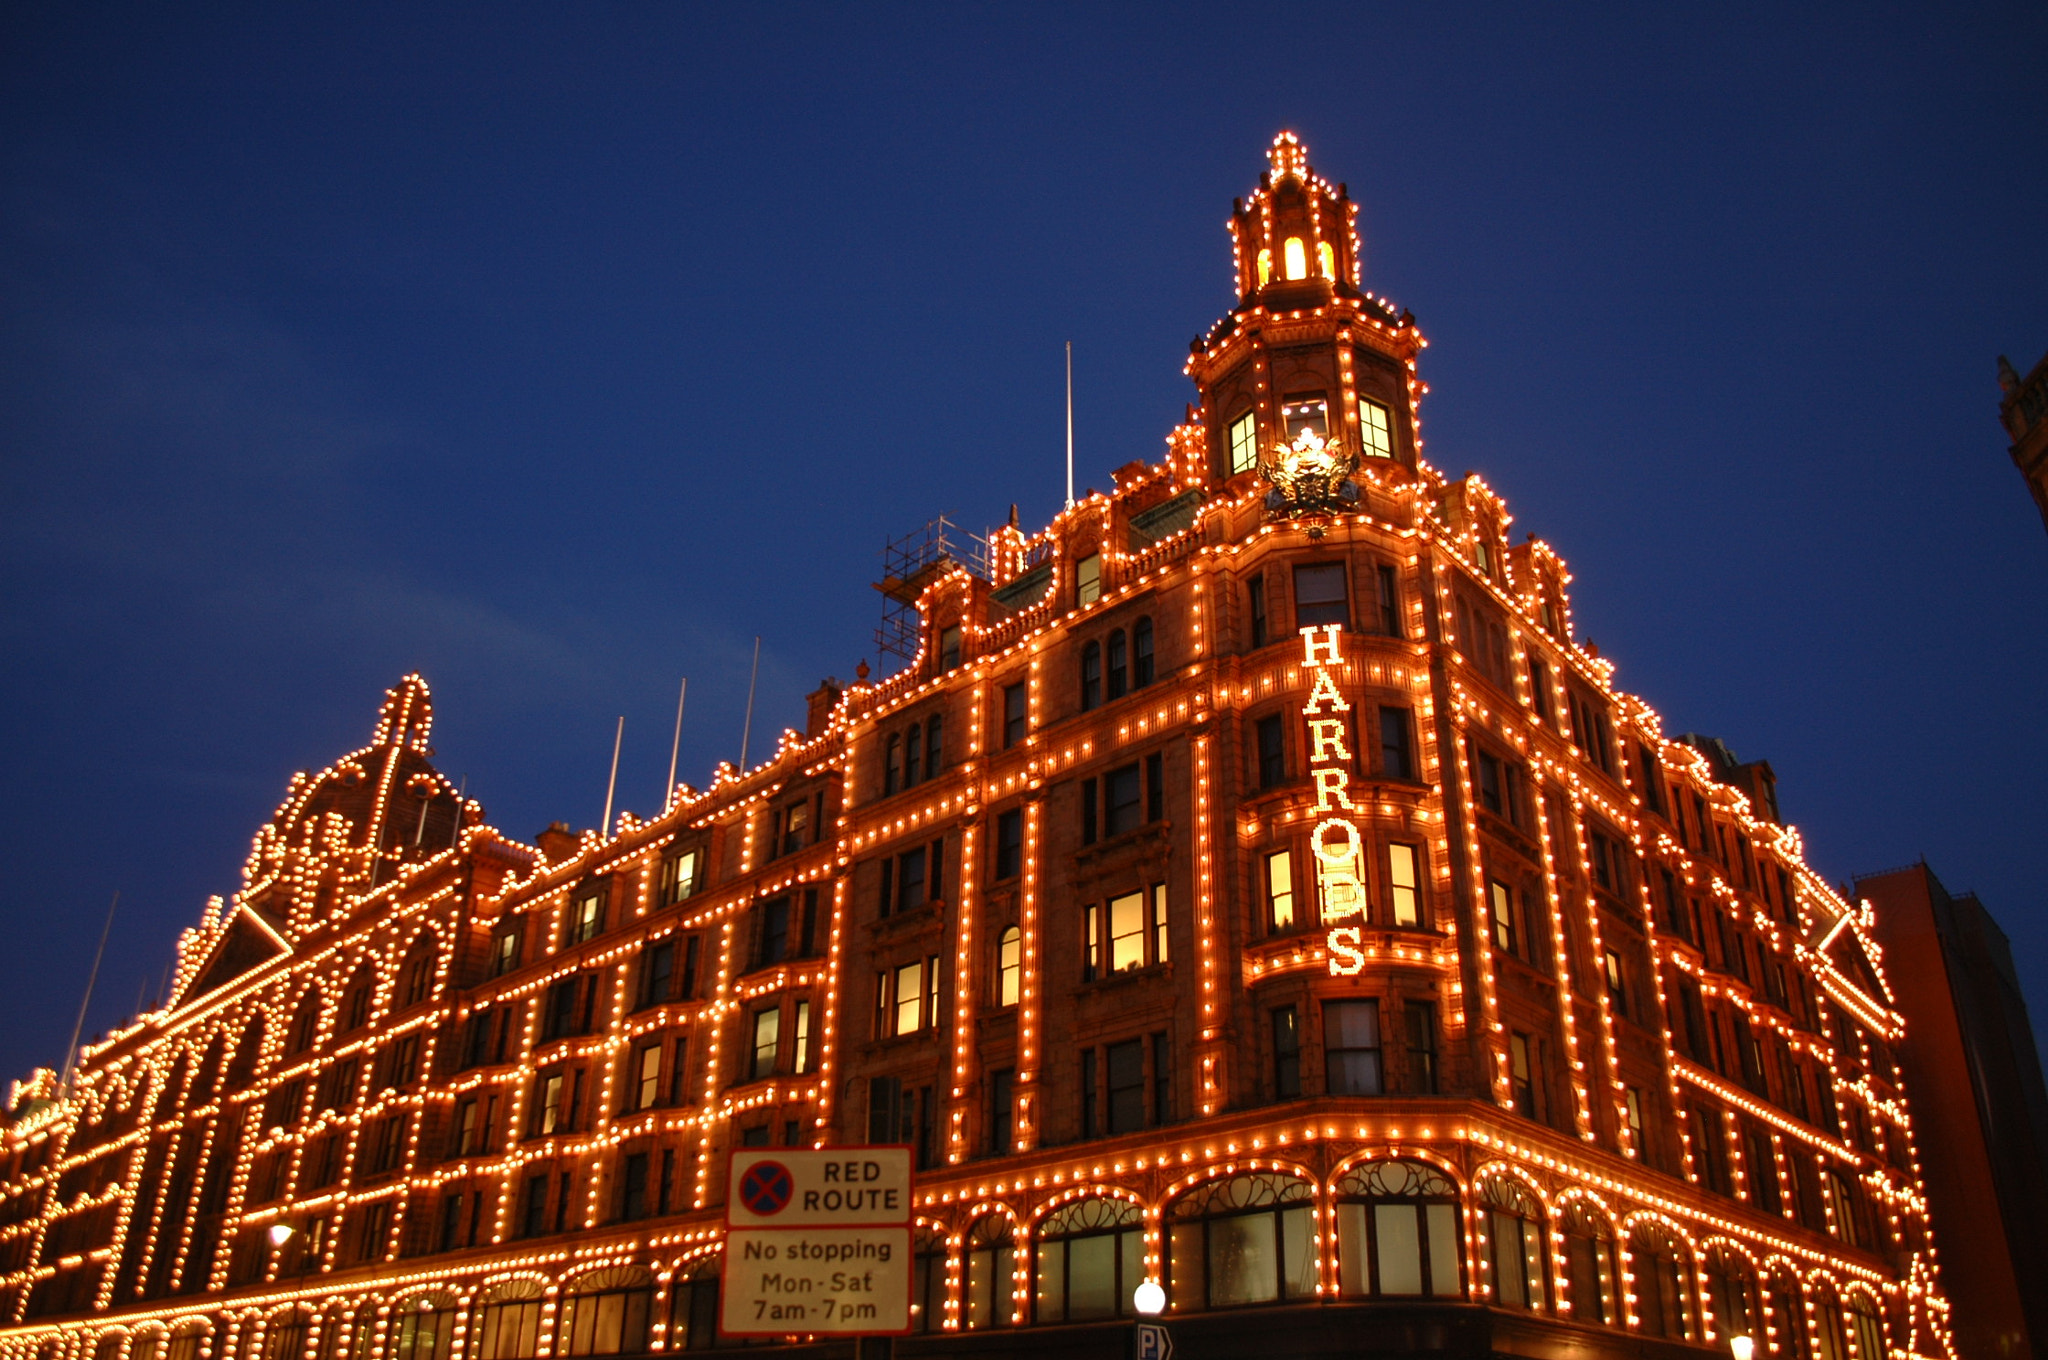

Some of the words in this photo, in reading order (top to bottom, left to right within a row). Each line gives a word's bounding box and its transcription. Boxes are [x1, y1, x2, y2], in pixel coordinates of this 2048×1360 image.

[1299, 623, 1366, 977] HARRODS
[824, 1161, 881, 1183] RED
[803, 1189, 899, 1212] ROUTE
[743, 1240, 777, 1260] No
[786, 1238, 892, 1263] stopping
[1141, 1329, 1155, 1358] P
